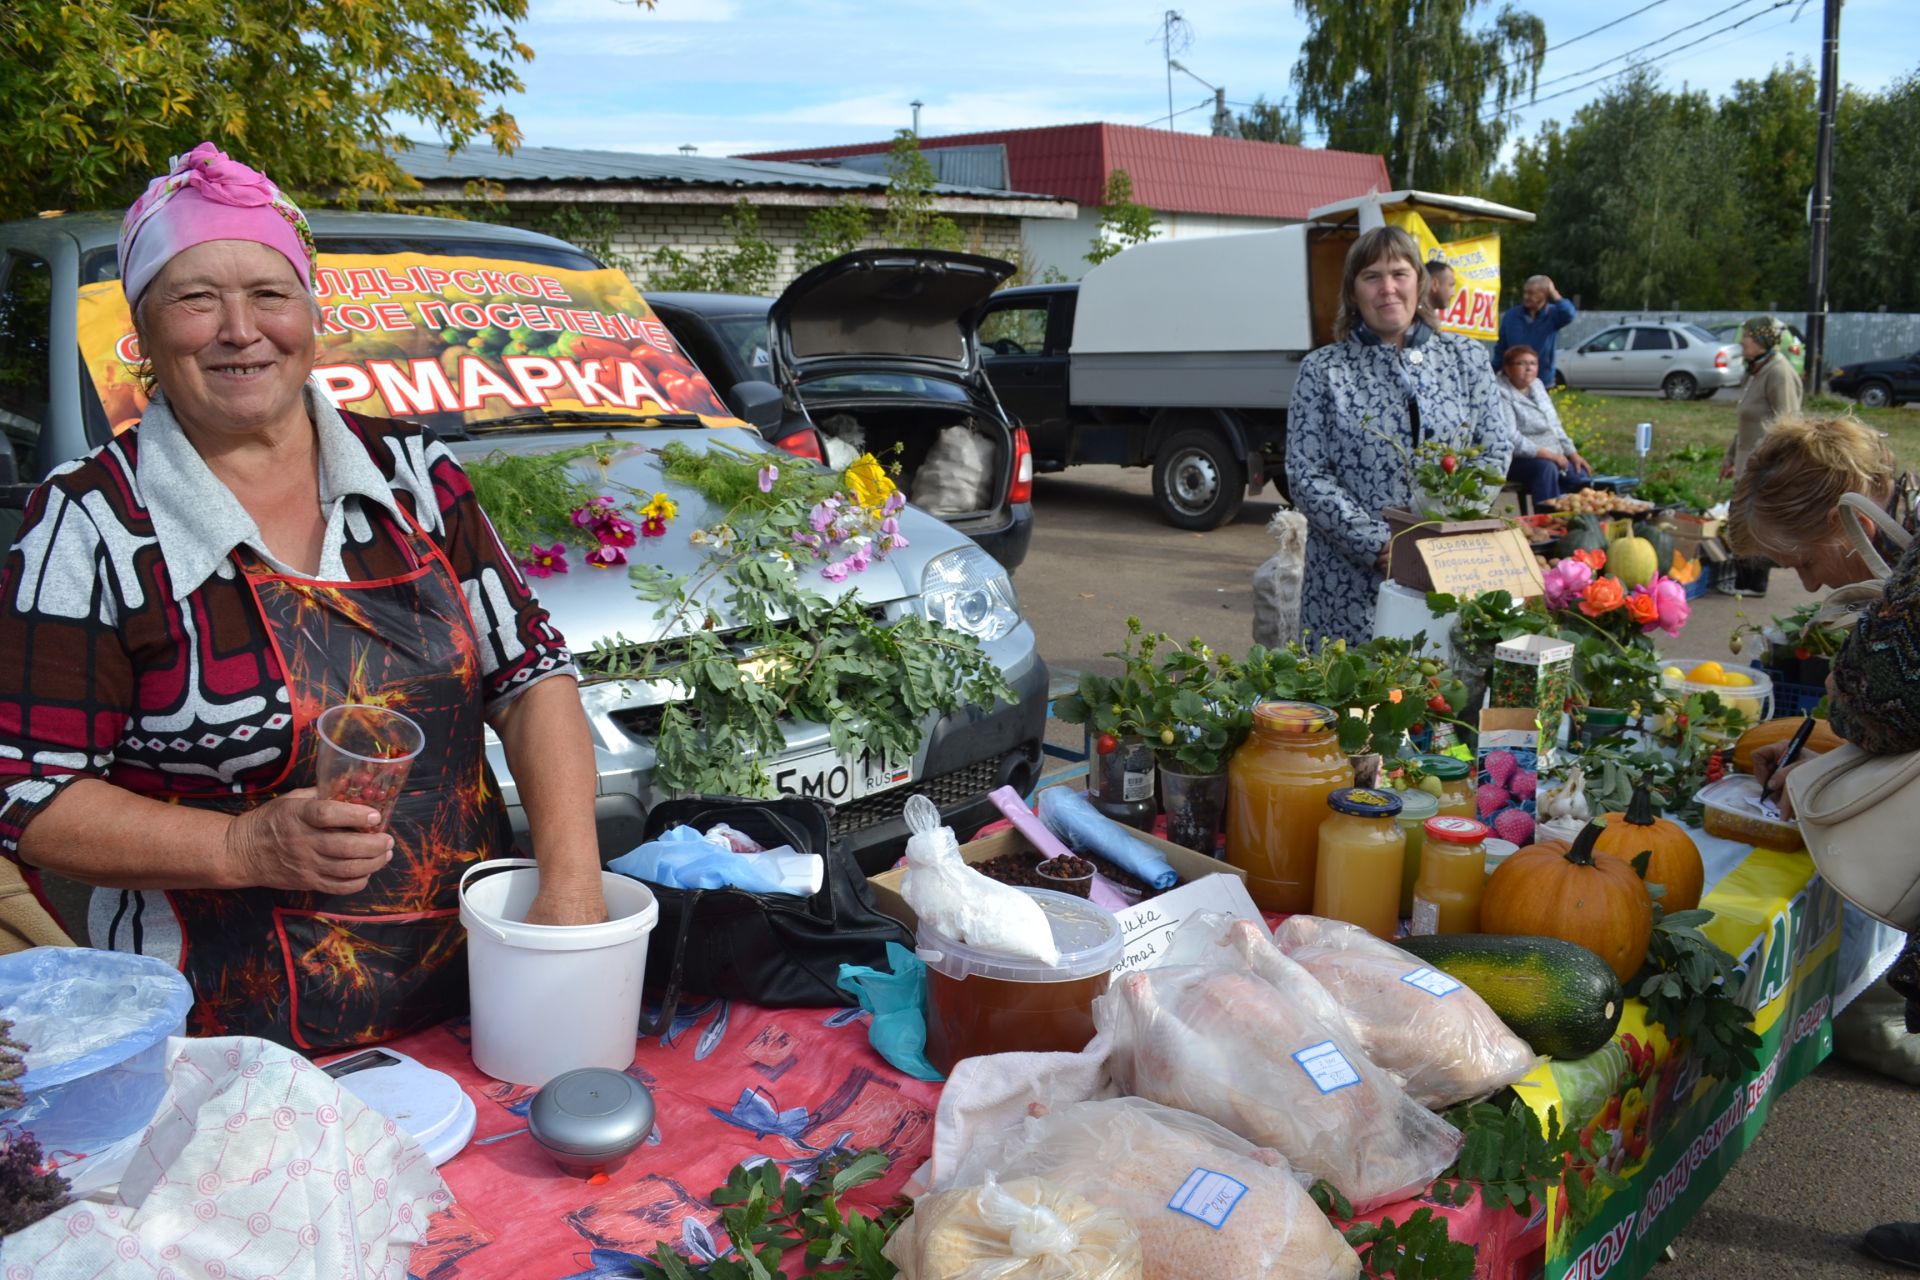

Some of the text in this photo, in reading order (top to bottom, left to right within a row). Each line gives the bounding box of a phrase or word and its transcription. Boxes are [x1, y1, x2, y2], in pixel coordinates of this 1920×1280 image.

[316, 266, 571, 302] ЛДЫРСКОЕ
[416, 300, 672, 352] ПОСЕЛЕНИЕ
[1440, 288, 1496, 329] АРК
[311, 356, 679, 416] РМАРКА
[866, 773, 891, 789] RUS
